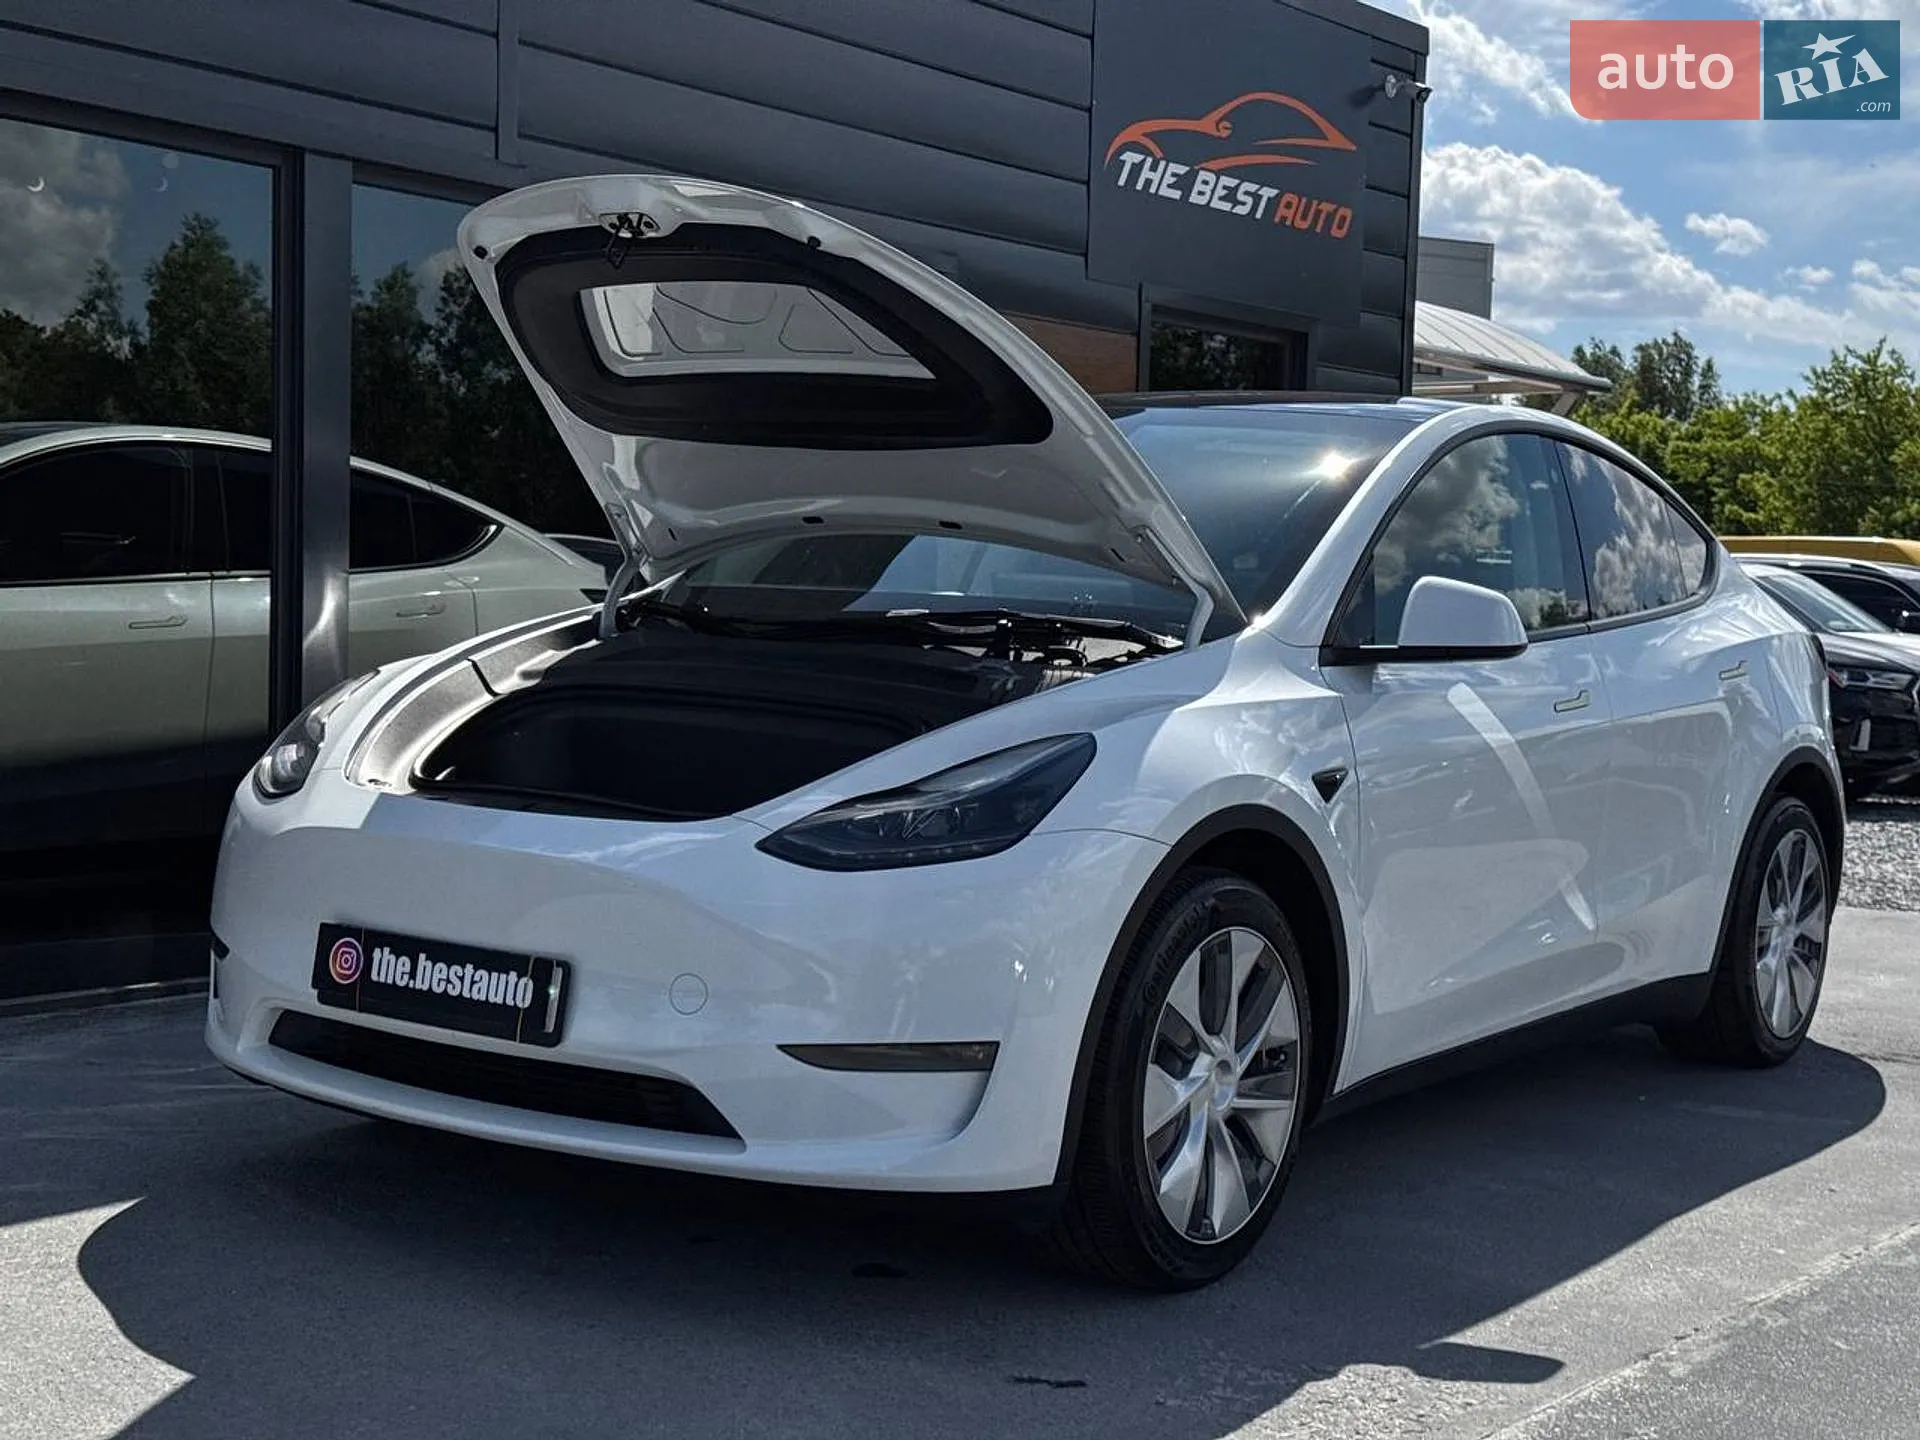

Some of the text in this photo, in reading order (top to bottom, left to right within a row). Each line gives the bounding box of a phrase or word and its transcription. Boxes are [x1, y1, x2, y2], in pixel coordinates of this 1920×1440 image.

[1117, 151, 1352, 238] THE BEST AUTO
[370, 947, 534, 1009] the.bestauto
